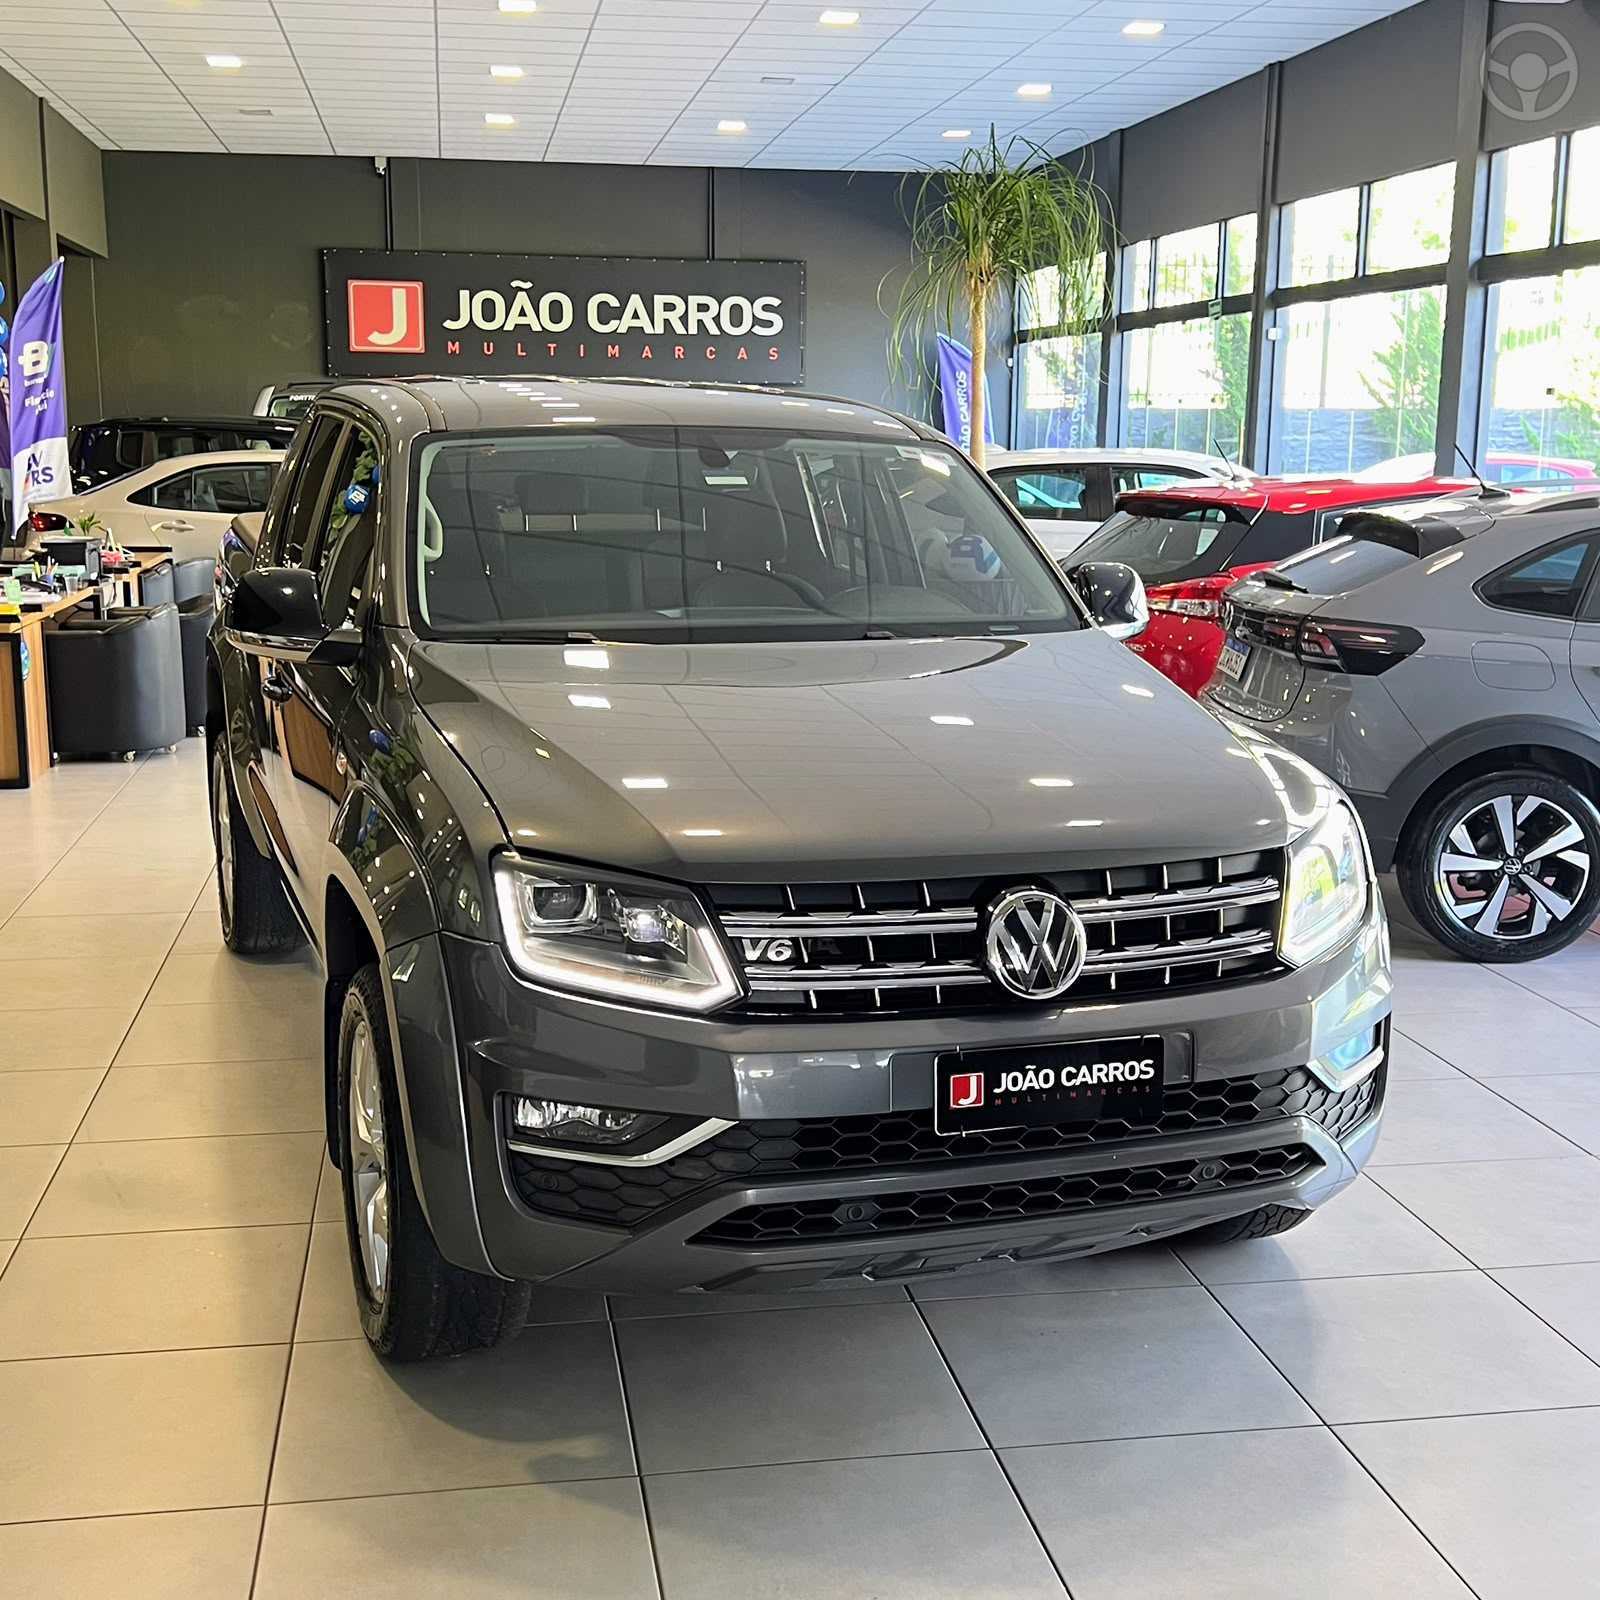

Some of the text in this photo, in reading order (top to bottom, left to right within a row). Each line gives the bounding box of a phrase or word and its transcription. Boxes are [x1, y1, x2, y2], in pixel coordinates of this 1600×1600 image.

[367, 287, 408, 346] J
[442, 280, 784, 337] JOÃO CARROS
[447, 341, 779, 361] MULTIMARCAS
[955, 370, 971, 455] OÃO CARROS
[741, 939, 793, 961] V6
[993, 1059, 1155, 1094] JOÃO CARROS
[994, 1085, 1151, 1106] MULTIMARCAS
